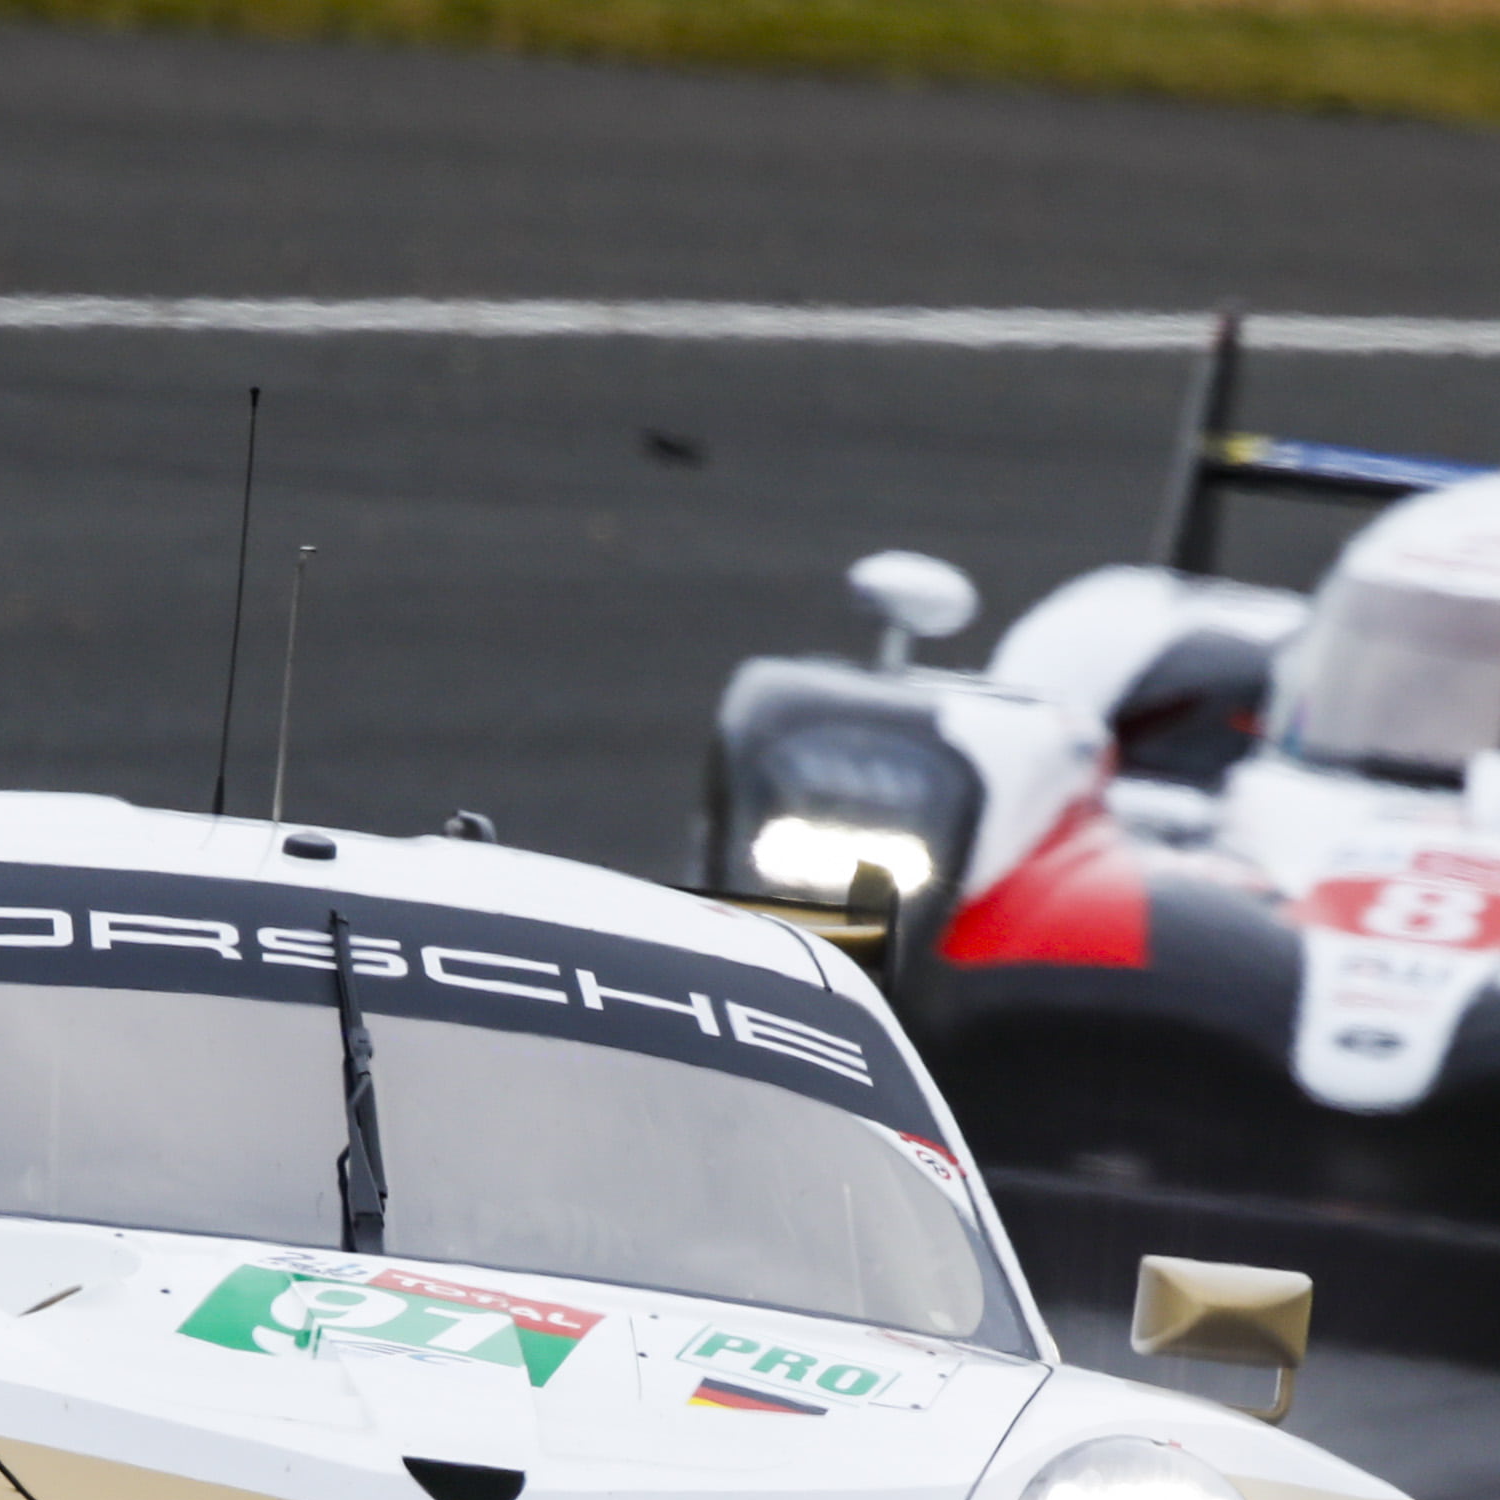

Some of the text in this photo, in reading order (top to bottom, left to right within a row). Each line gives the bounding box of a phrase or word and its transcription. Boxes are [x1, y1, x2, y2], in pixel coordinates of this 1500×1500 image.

[1362, 879, 1487, 943] 8
[250, 1280, 518, 1357] 91
[392, 1274, 582, 1330] TOTAL
[694, 1331, 882, 1397] PRO
